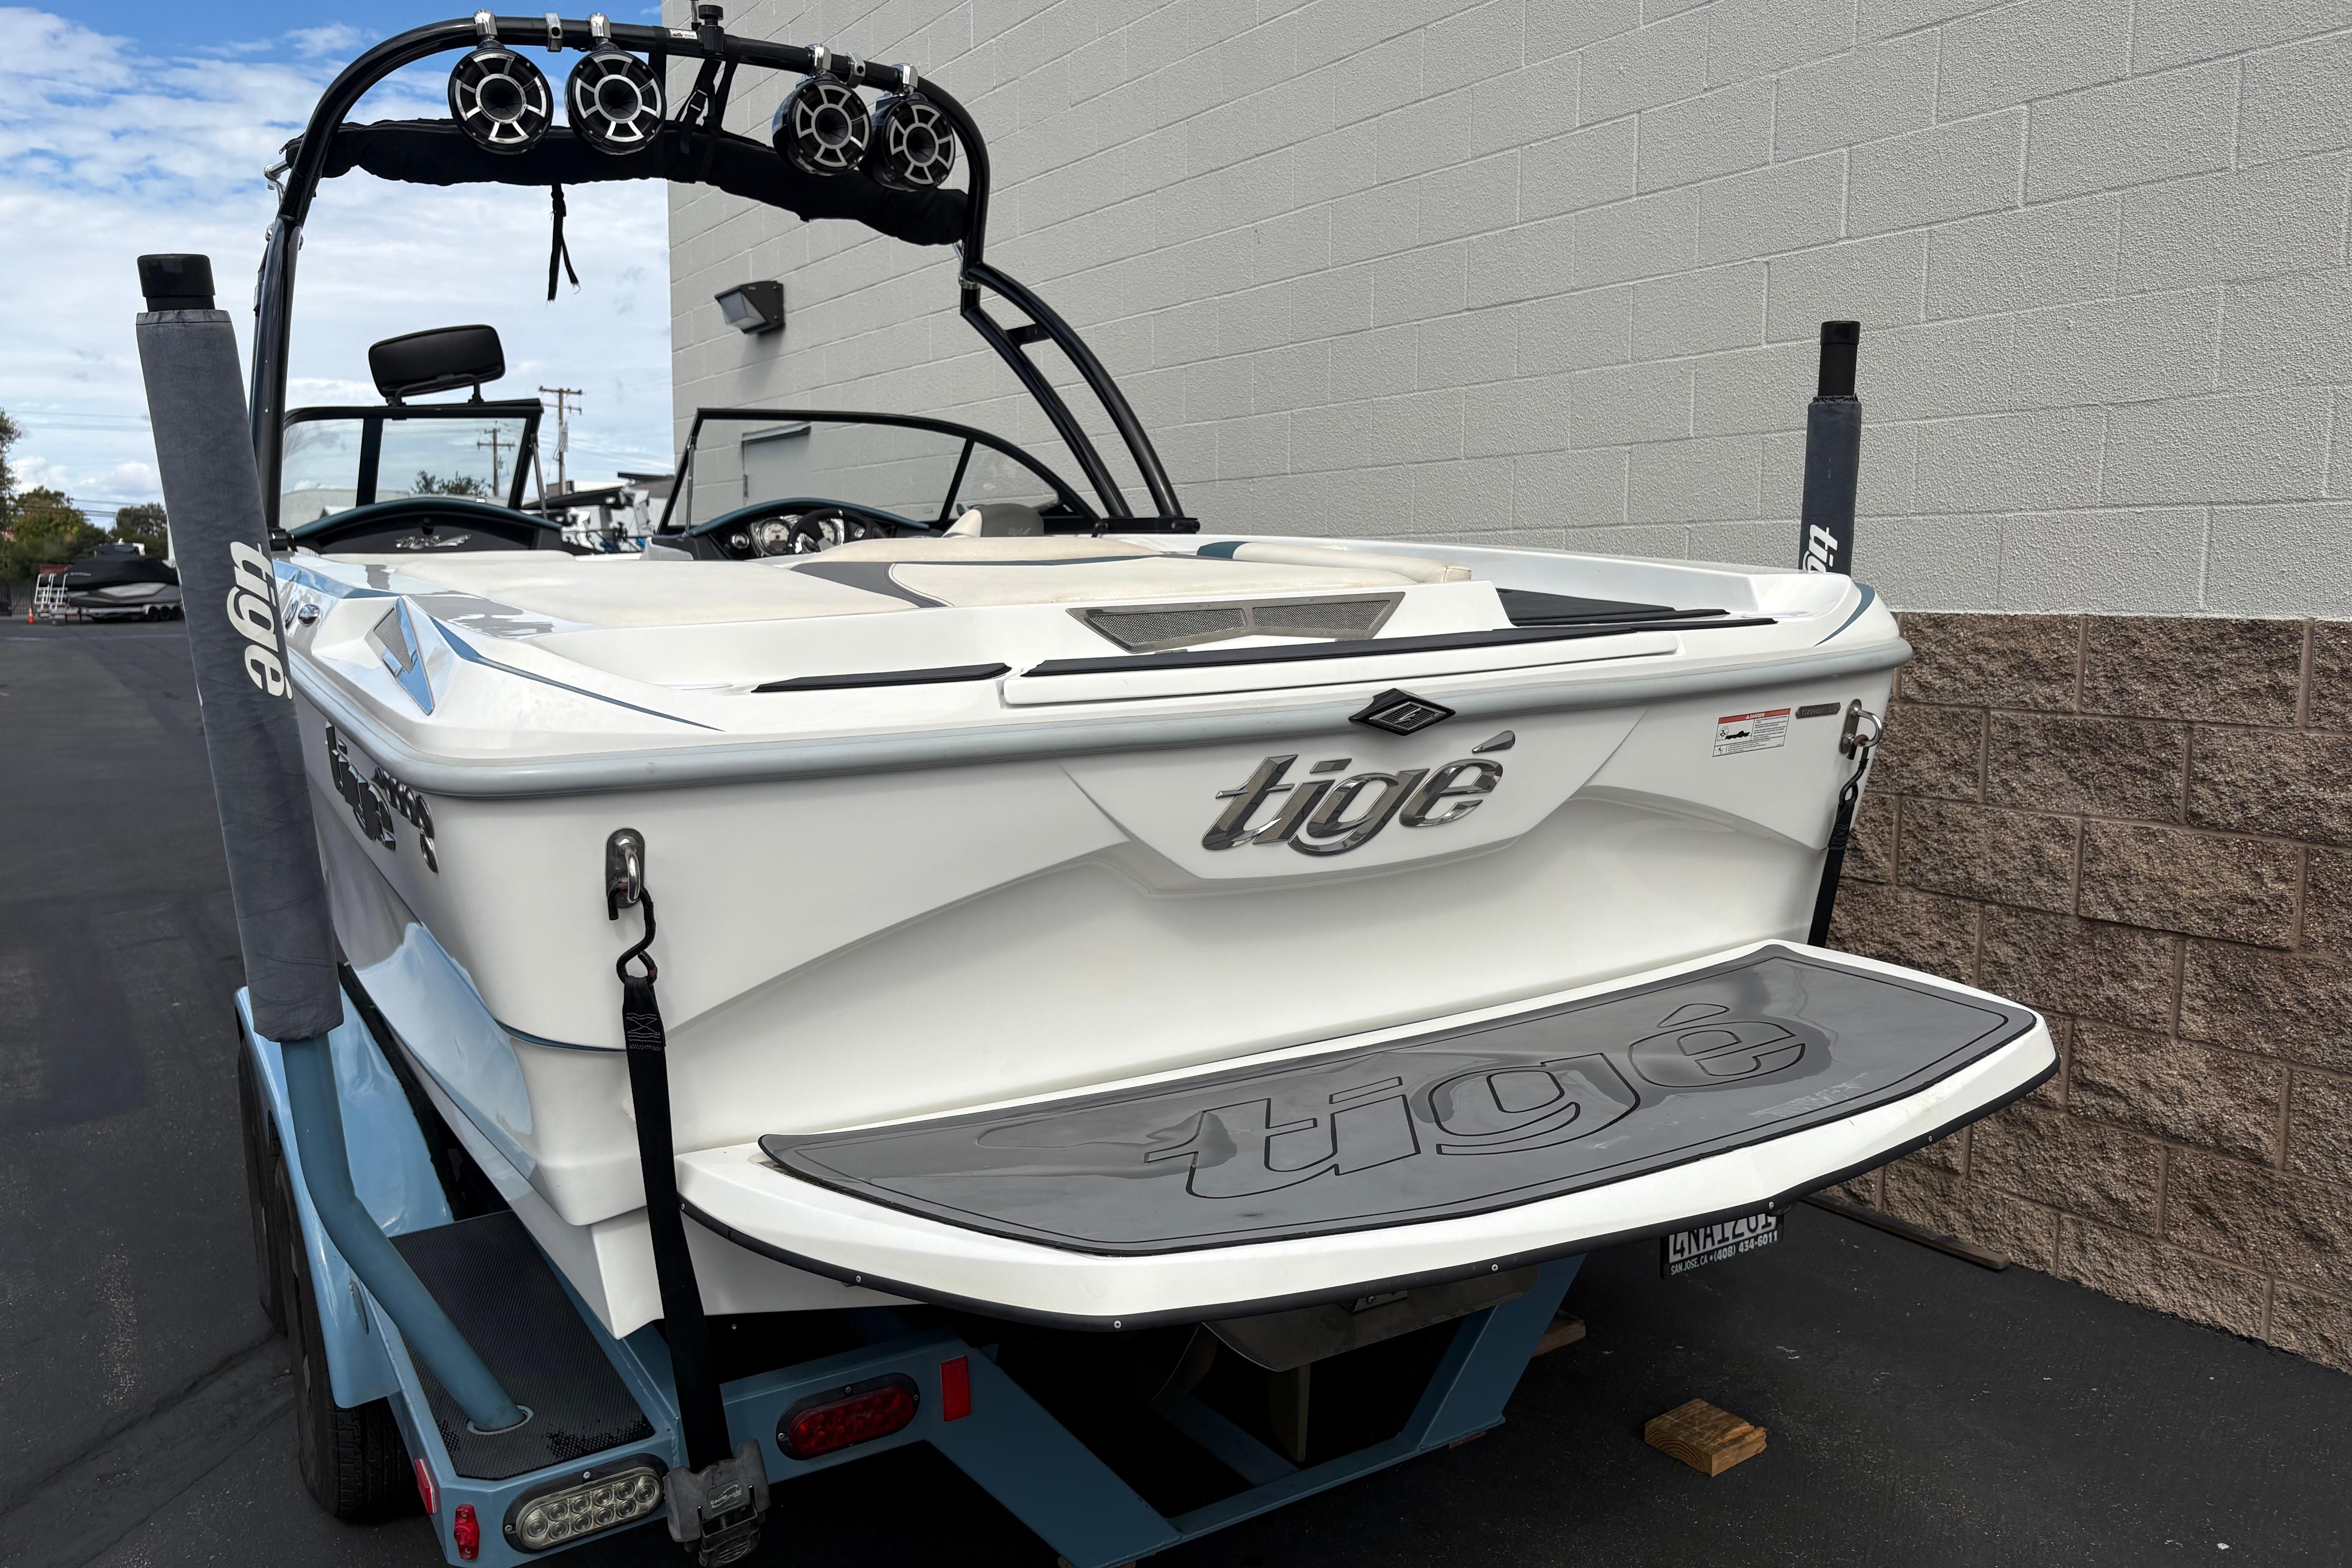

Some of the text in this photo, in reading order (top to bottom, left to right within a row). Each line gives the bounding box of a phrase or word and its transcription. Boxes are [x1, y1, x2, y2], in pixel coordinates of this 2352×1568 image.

[227, 541, 293, 700] tigé
[1202, 730, 1515, 856] tigé
[1143, 1003, 1806, 1199] tigé
[1671, 1262, 1682, 1275] SAN
[1683, 1258, 1699, 1272] JOSE,
[1700, 1255, 1708, 1265] CA
[1714, 1244, 1736, 1262] (408)
